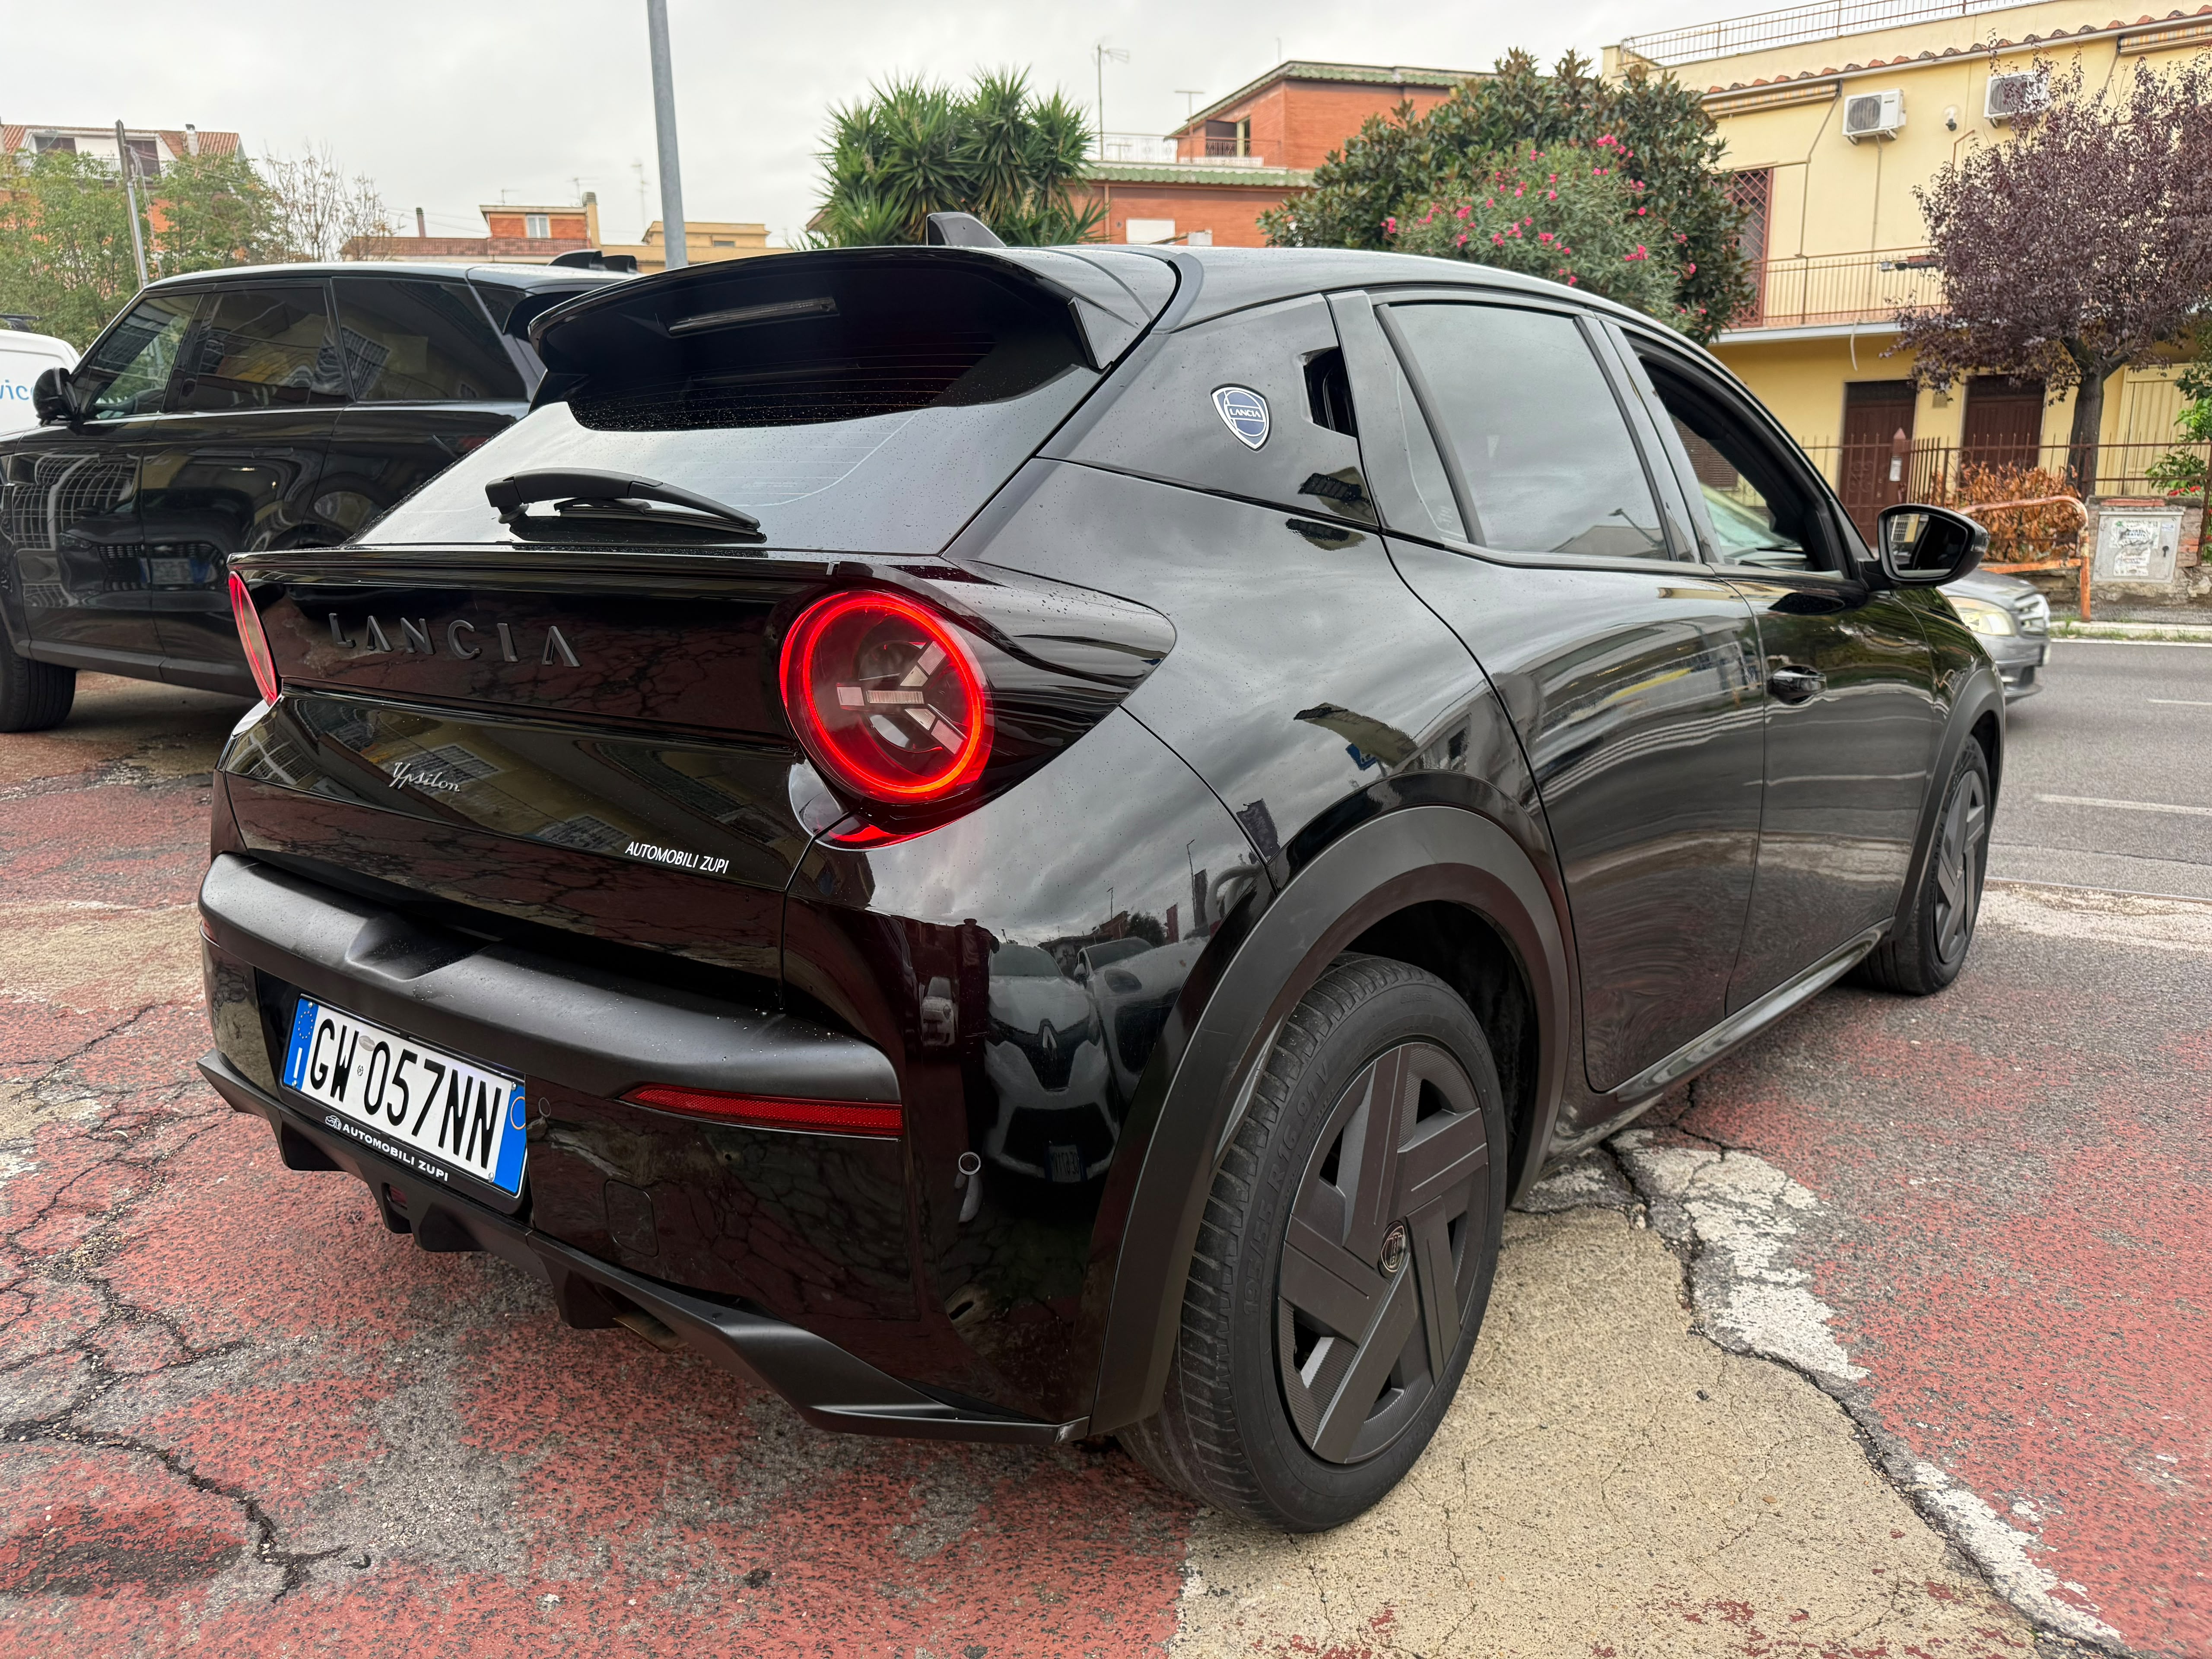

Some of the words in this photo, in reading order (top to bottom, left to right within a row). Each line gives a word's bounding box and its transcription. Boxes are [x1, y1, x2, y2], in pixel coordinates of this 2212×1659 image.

[1229, 408, 1261, 418] LANCIA
[328, 613, 582, 667] LANCIA
[389, 762, 460, 792] Ypsilon
[625, 841, 699, 868] AUTOMOBILI
[699, 856, 729, 874] ZUPI
[343, 1124, 415, 1165] AUTOMOBILI
[418, 1160, 449, 1182] ZUPI
